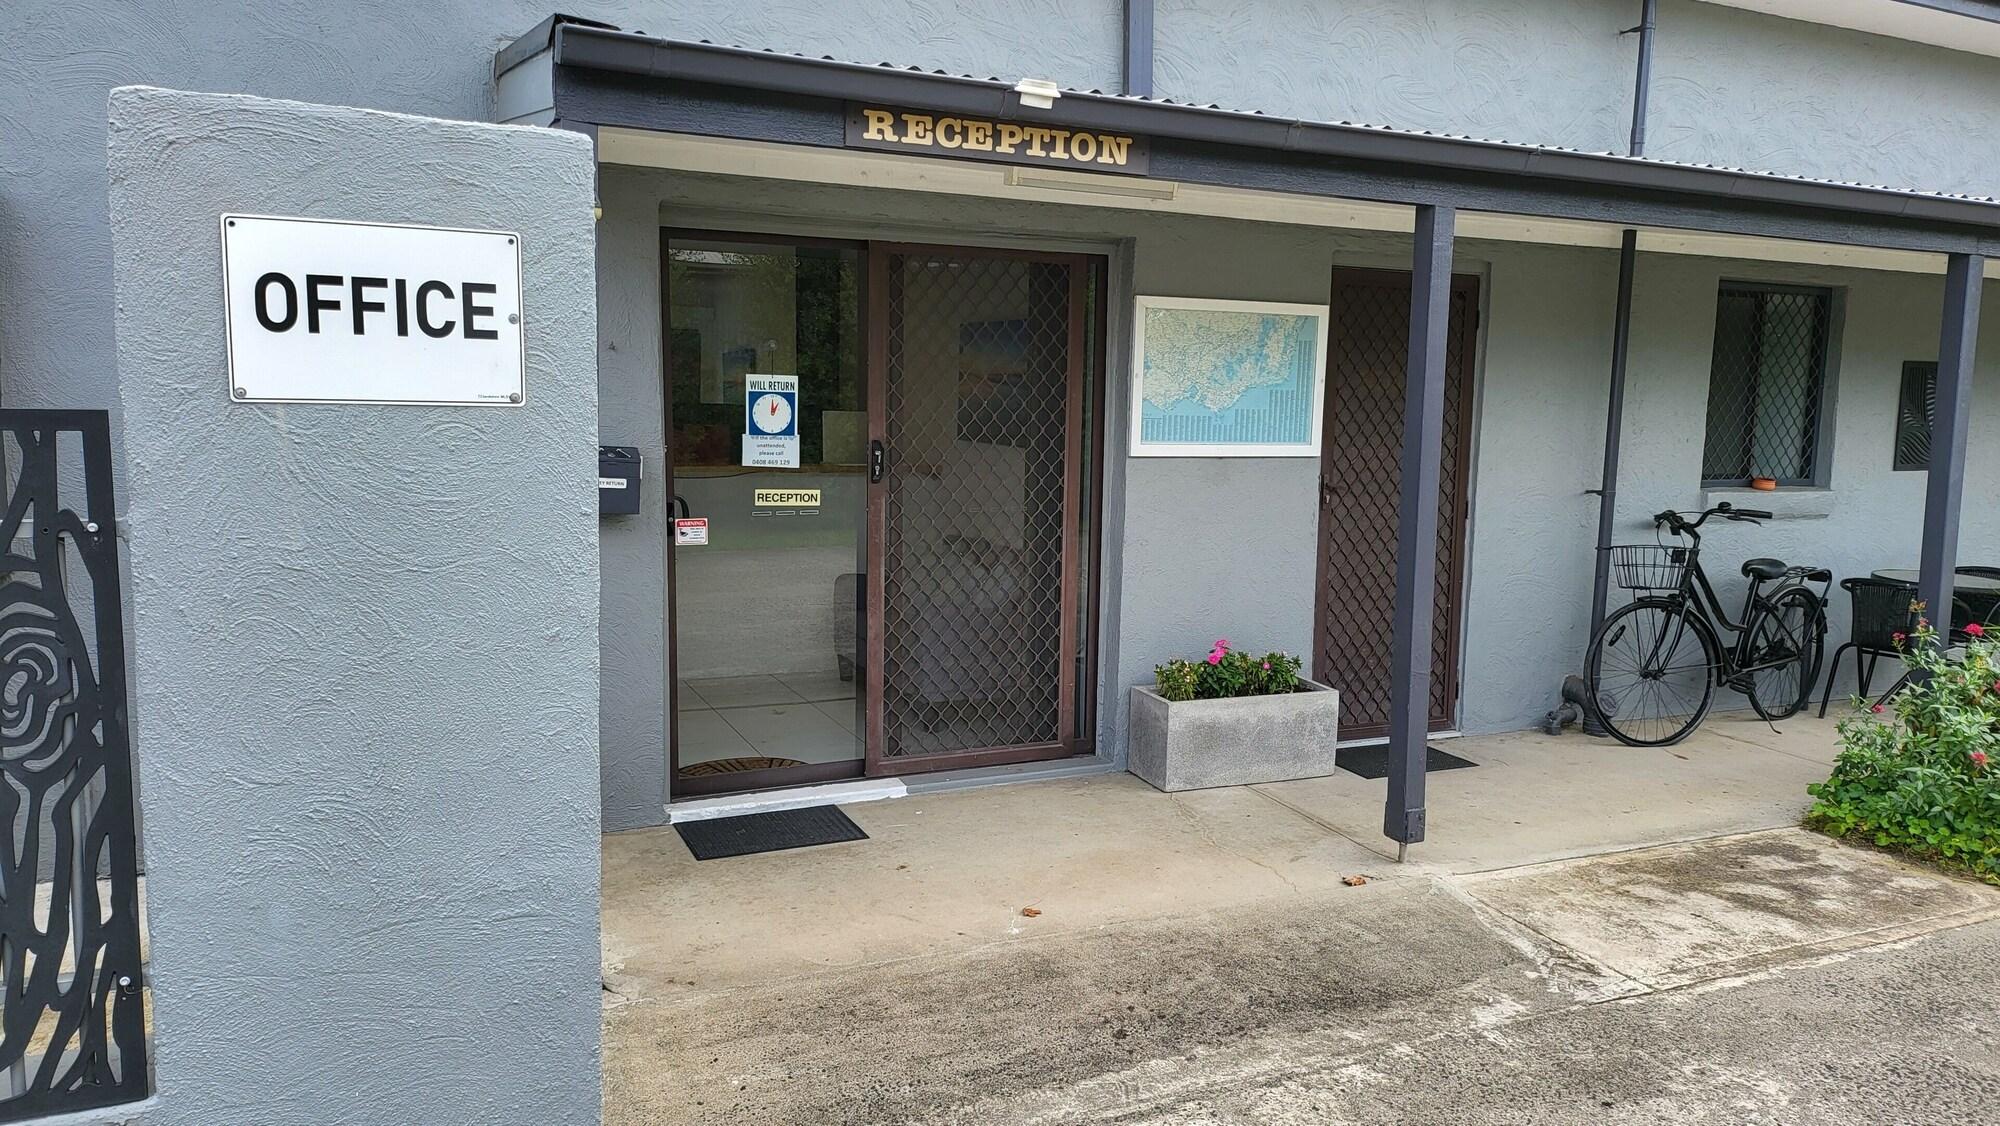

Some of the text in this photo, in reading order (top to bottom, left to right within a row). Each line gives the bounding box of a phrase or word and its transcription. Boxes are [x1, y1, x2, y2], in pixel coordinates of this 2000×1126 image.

[862, 109, 1133, 166] RECEPTION
[254, 271, 499, 340] OFFICE
[750, 380, 795, 391] WILL RETURN
[757, 493, 818, 503] RECEPTION
